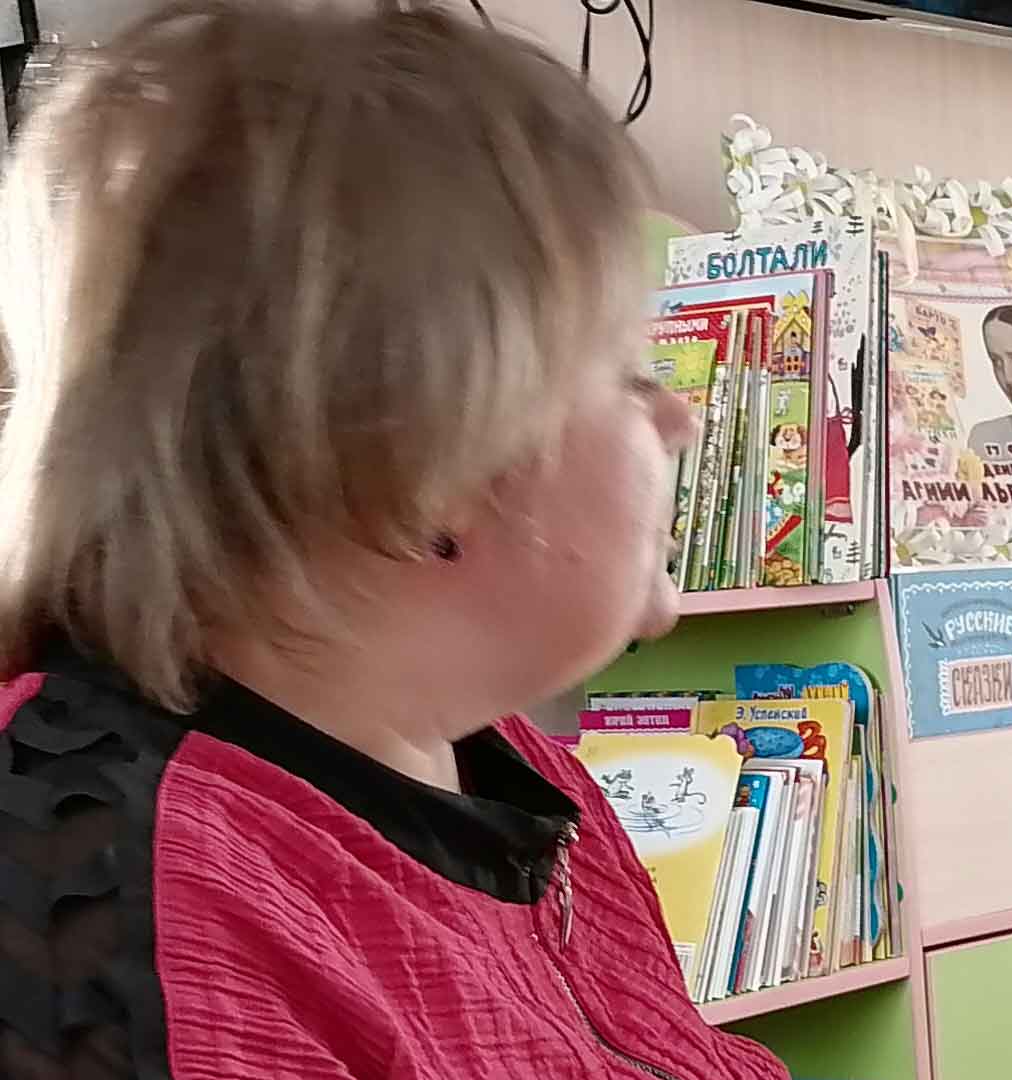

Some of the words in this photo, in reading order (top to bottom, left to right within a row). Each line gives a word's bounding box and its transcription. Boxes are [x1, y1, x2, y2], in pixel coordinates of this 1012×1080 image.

[706, 239, 829, 280] БОЛТАЛИ
[901, 479, 971, 503] АГНИИ
[749, 706, 808, 721] Успенский
